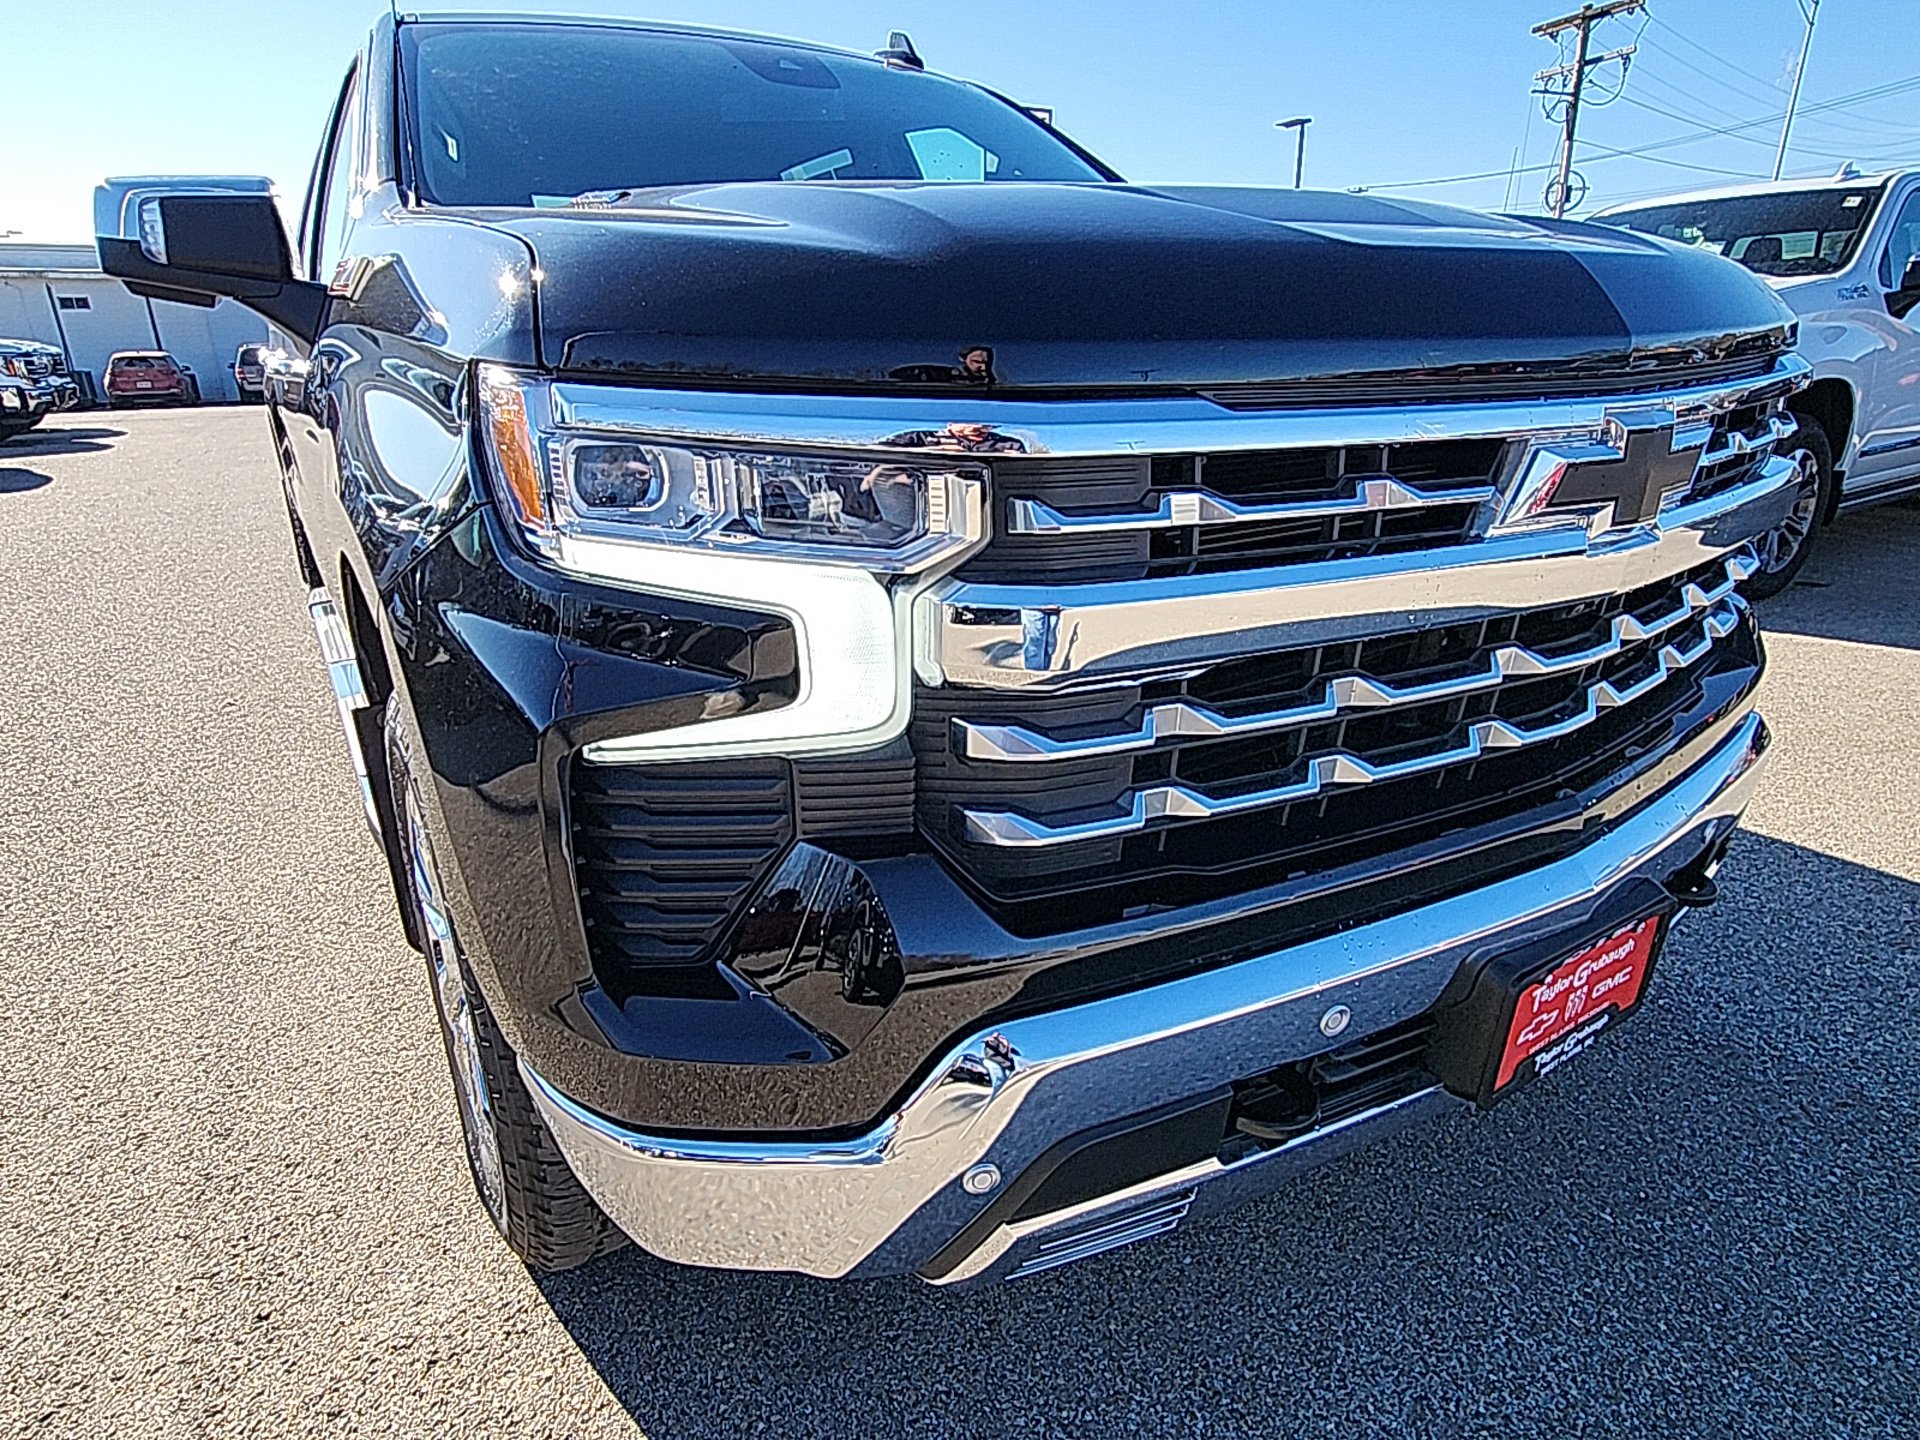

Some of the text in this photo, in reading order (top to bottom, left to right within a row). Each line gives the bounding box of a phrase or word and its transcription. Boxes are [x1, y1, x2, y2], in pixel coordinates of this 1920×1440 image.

[1532, 975, 1574, 1013] Taylor
[1573, 938, 1635, 988] Grubaugh
[1592, 966, 1633, 999] GMC
